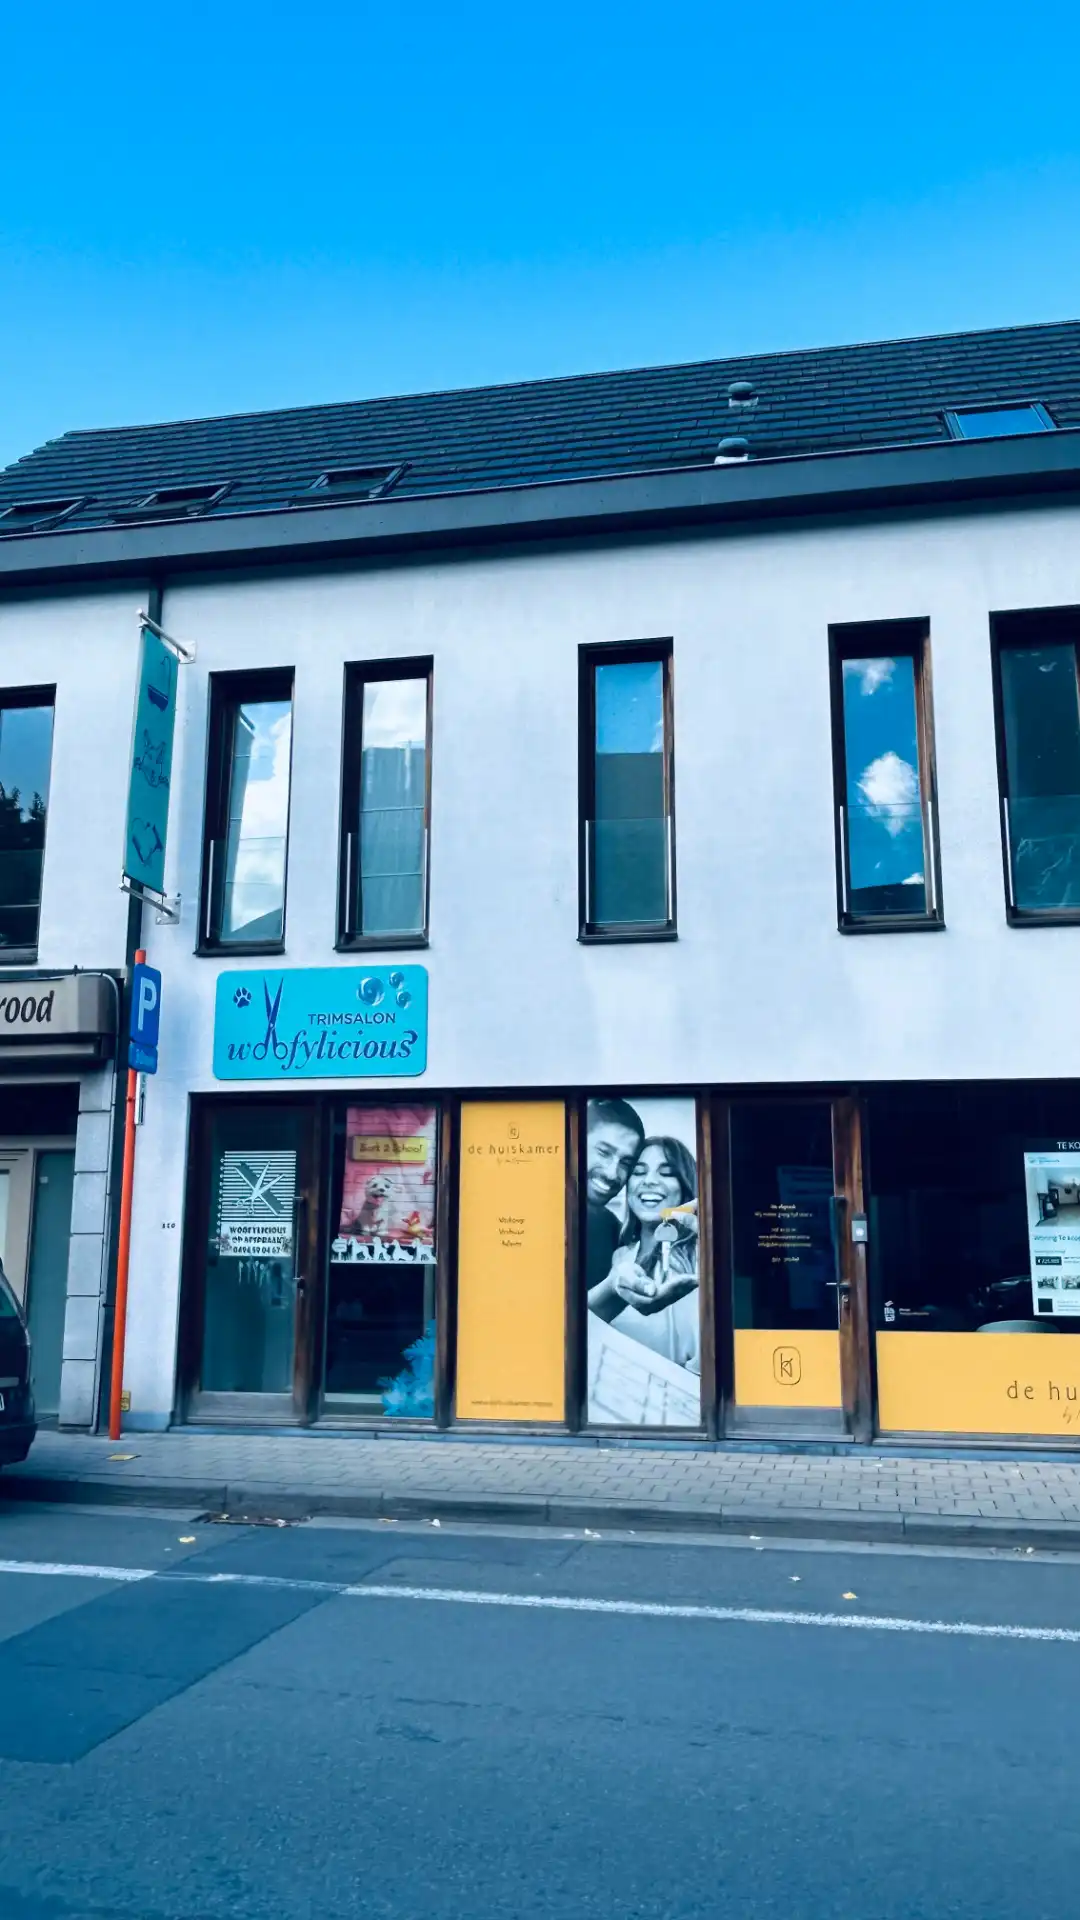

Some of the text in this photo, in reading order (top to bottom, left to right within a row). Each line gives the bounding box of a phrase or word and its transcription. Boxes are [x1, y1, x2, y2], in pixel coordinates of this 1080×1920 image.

[138, 977, 157, 1031] P
[308, 1012, 396, 1025] TRIMSALON
[467, 1144, 560, 1155] de huiskamer
[1056, 1141, 1067, 1150] TE
[1006, 1380, 1034, 1400] de
